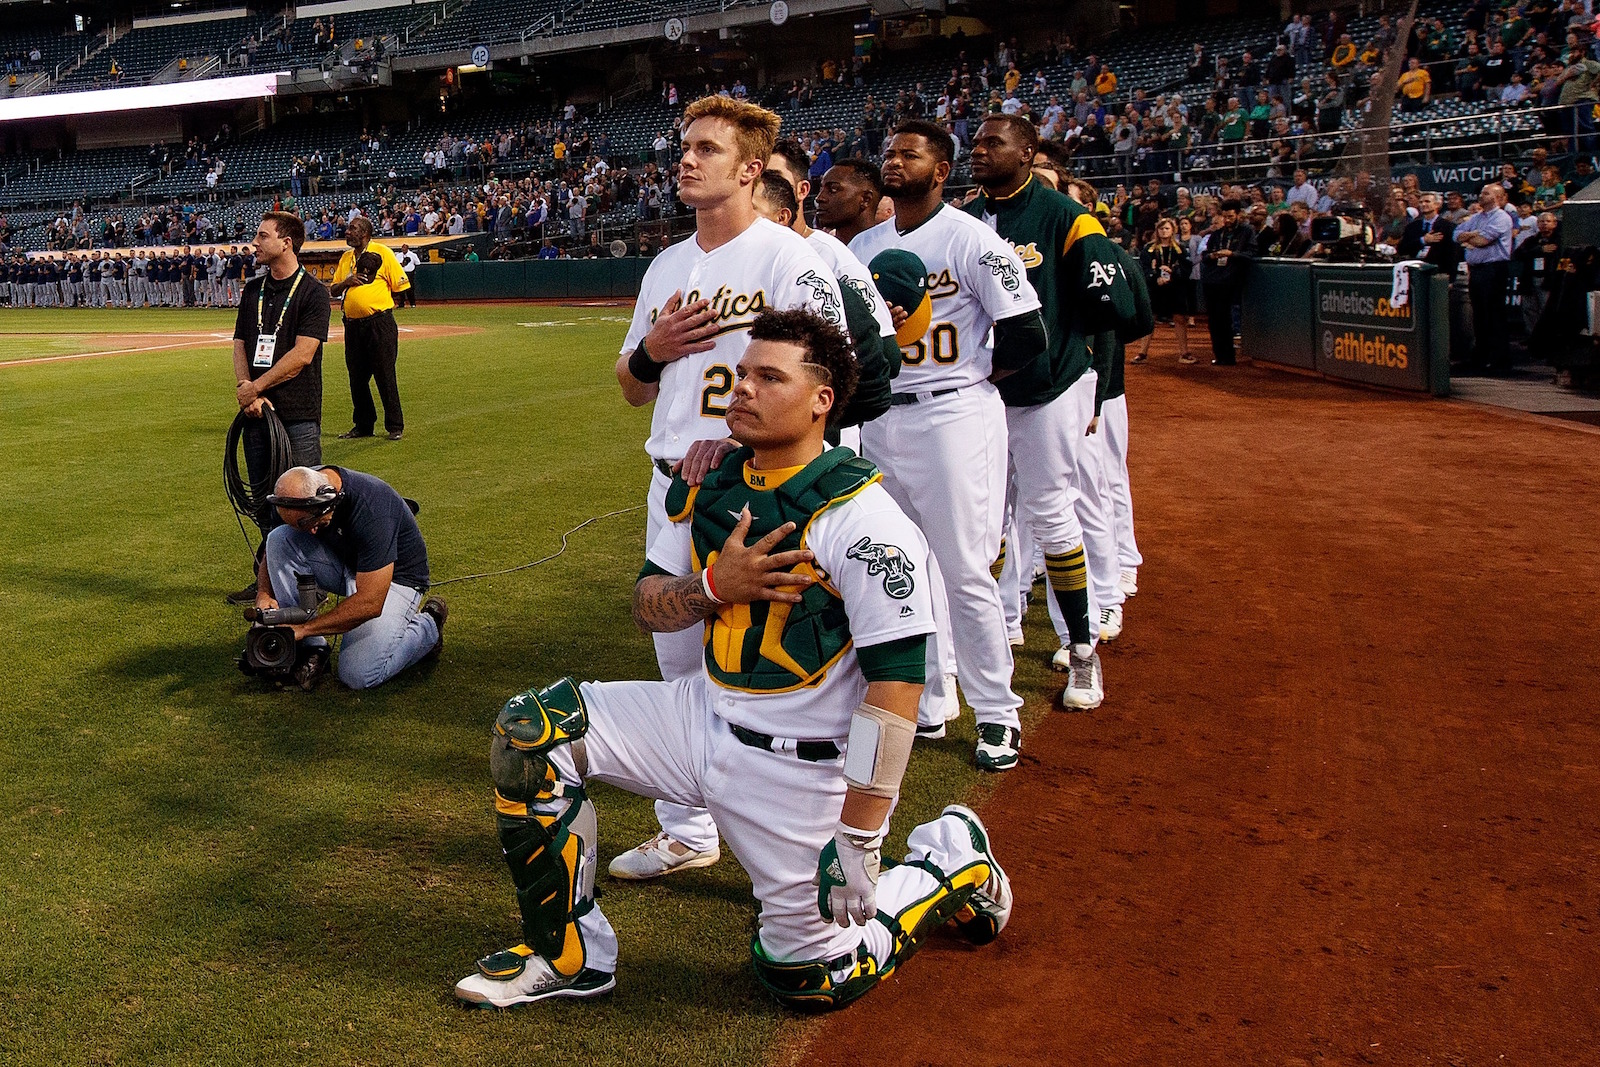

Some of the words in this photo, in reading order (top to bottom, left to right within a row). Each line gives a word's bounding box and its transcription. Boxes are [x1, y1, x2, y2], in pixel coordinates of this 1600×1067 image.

[474, 50, 486, 61] 42
[1087, 260, 1117, 288] A's
[700, 363, 735, 419] 2
[750, 474, 766, 487] BM
